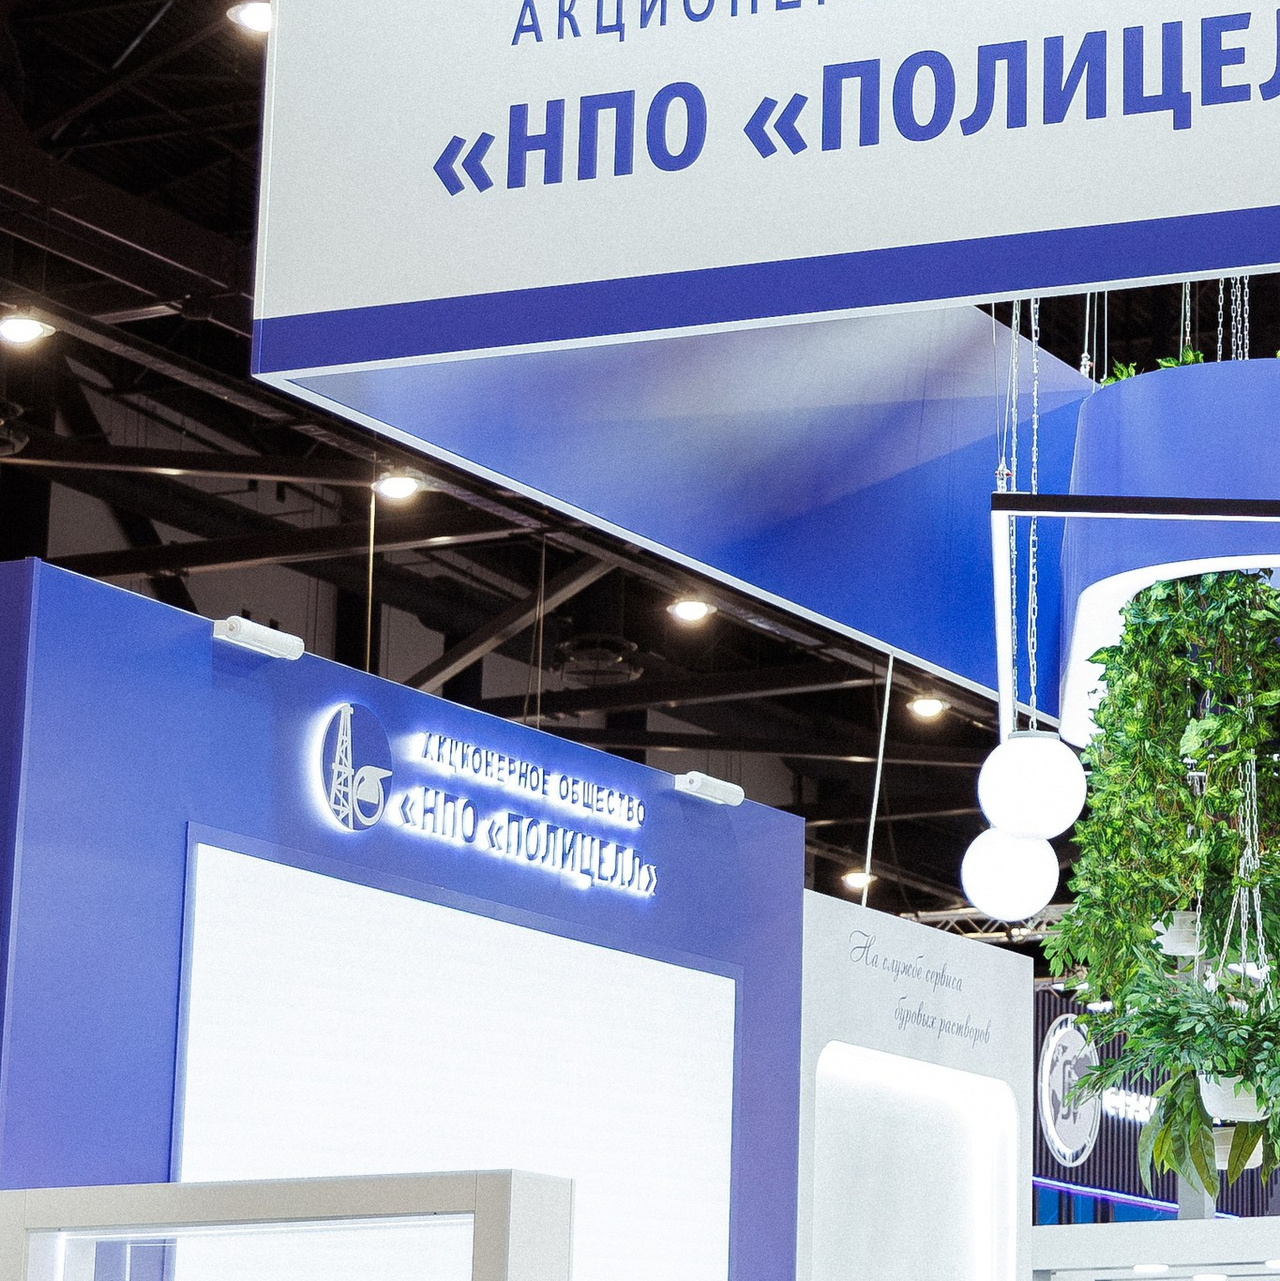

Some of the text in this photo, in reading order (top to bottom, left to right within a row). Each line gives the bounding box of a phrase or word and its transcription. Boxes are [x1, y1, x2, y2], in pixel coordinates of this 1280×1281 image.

[432, 80, 708, 198] «НПО
[421, 731, 646, 828] АКЦИОНЕРНОЕ ОБЩЕСТВО
[399, 786, 658, 896] «НПО «ПОЛИЦЕЛЛ»
[849, 930, 963, 993] На службе сервиса
[895, 995, 992, 1050] буровых растворов
